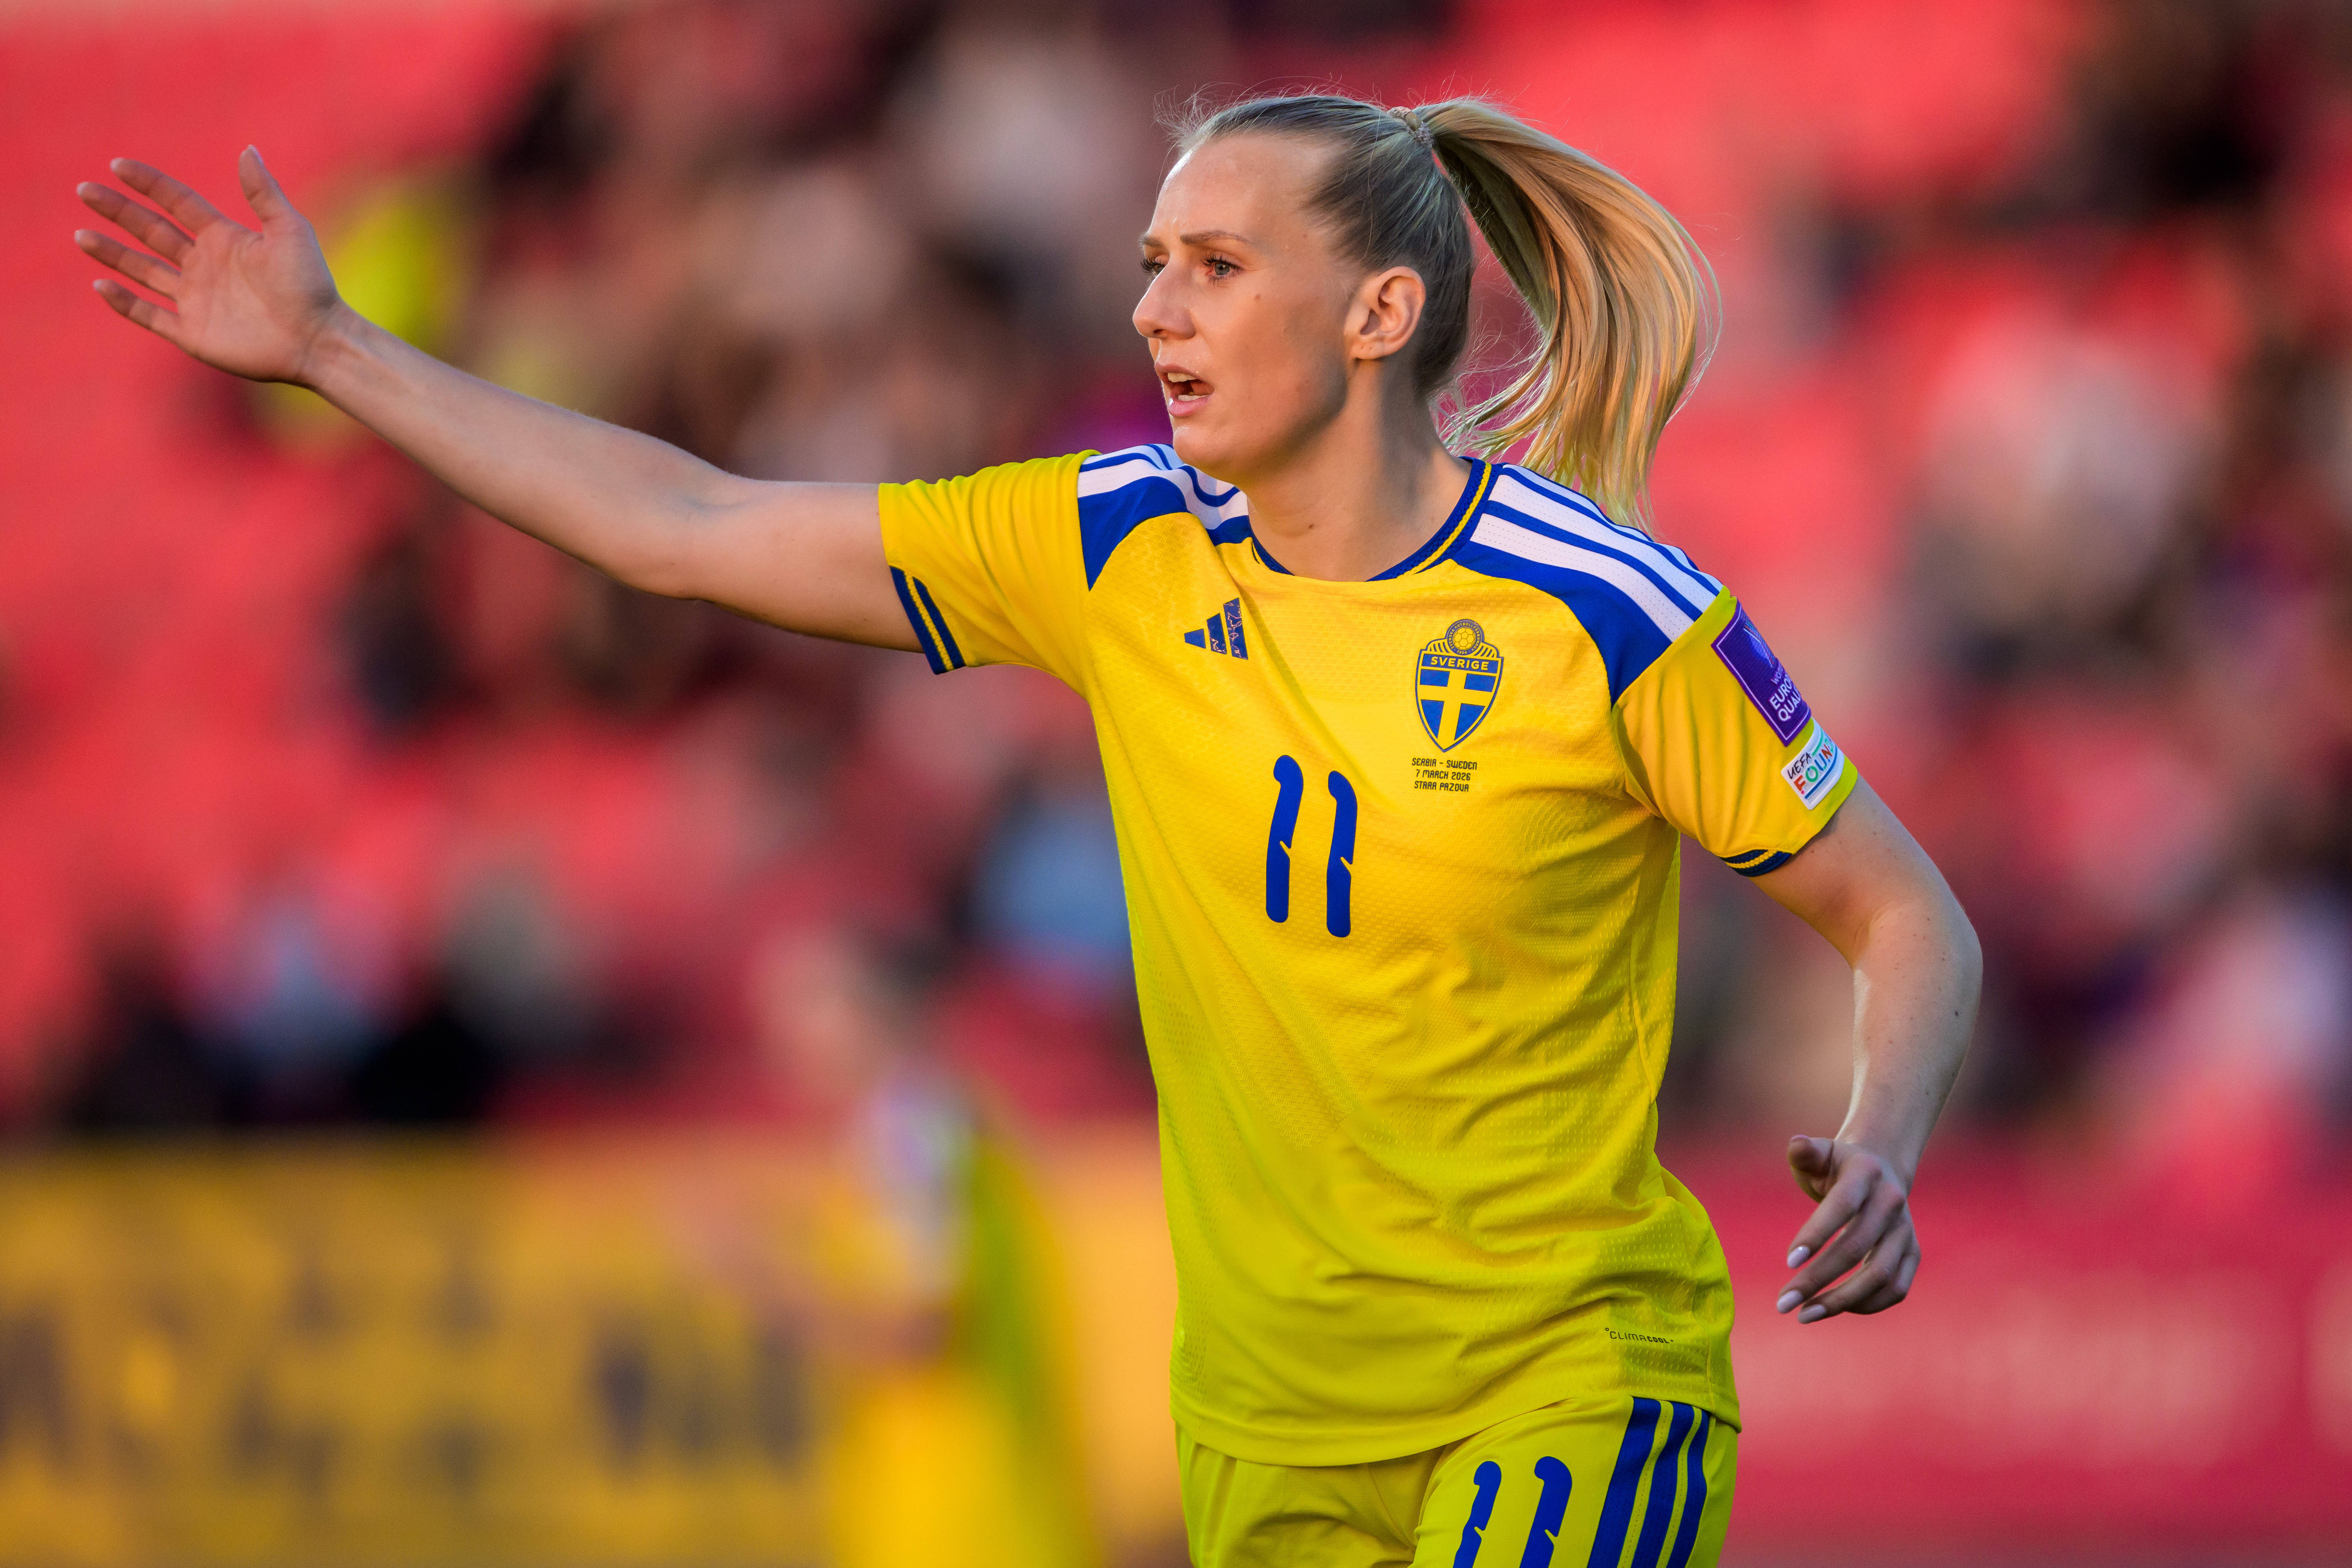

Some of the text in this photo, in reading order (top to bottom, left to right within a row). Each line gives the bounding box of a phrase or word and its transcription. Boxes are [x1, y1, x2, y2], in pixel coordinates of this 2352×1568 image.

[1430, 656, 1489, 670] SVERIGE
[1412, 758, 1437, 767] SERBIA
[1446, 760, 1477, 770] SWEDEN
[1787, 752, 1812, 779] UEFA
[1416, 769, 1471, 780] 7 MARCH 2026
[1414, 780, 1469, 792] STARA PAZOVA
[1265, 755, 1358, 938] 11
[1452, 1456, 1573, 1568] 11
